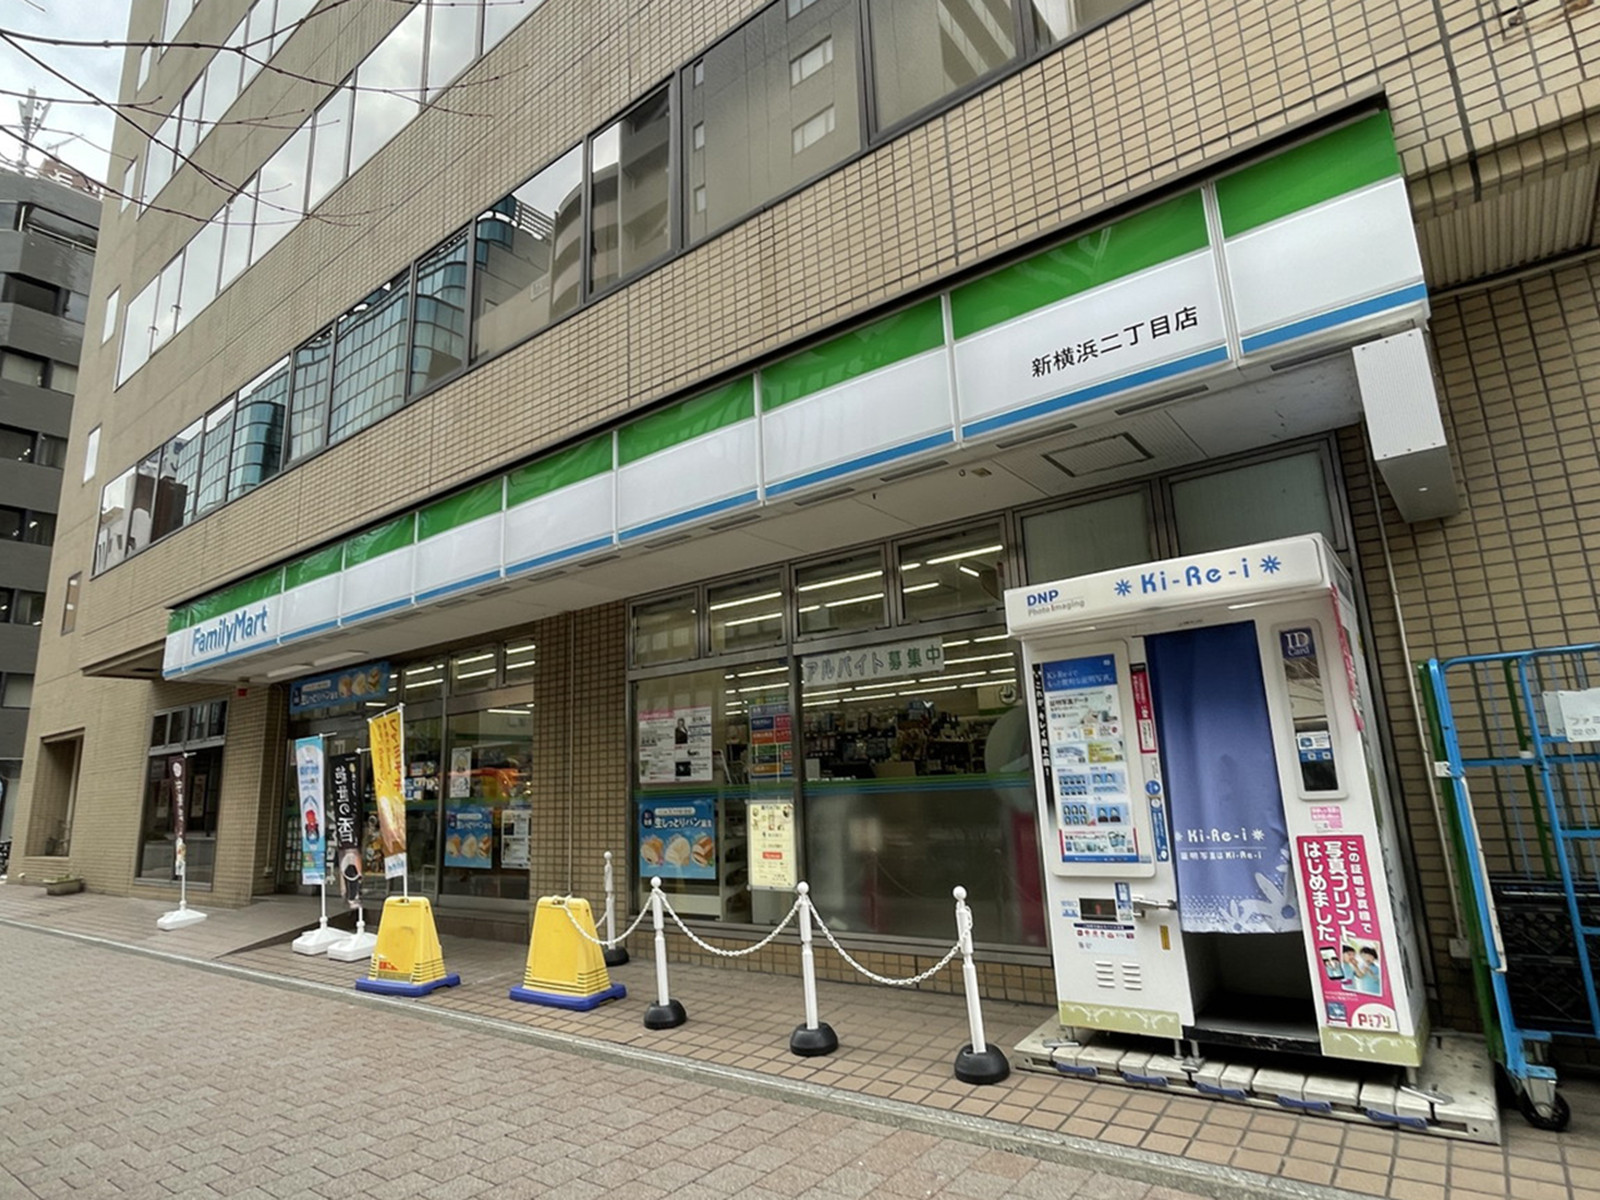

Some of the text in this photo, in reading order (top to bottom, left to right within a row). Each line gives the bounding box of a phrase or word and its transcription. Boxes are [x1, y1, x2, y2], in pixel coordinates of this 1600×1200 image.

[1032, 306, 1199, 378] 新横浜二丁目店
[1027, 590, 1060, 607] DNP
[1140, 557, 1250, 595] Ki-Re-i
[192, 604, 268, 656] FamilyMart
[1284, 631, 1310, 649] ID
[804, 644, 942, 682] アルバイト募集中
[1187, 827, 1248, 843] Ki-Re-i
[1303, 841, 1337, 942] はじめました
[1323, 841, 1357, 943] 写真プリント
[1347, 841, 1372, 934] この証明写真機で
